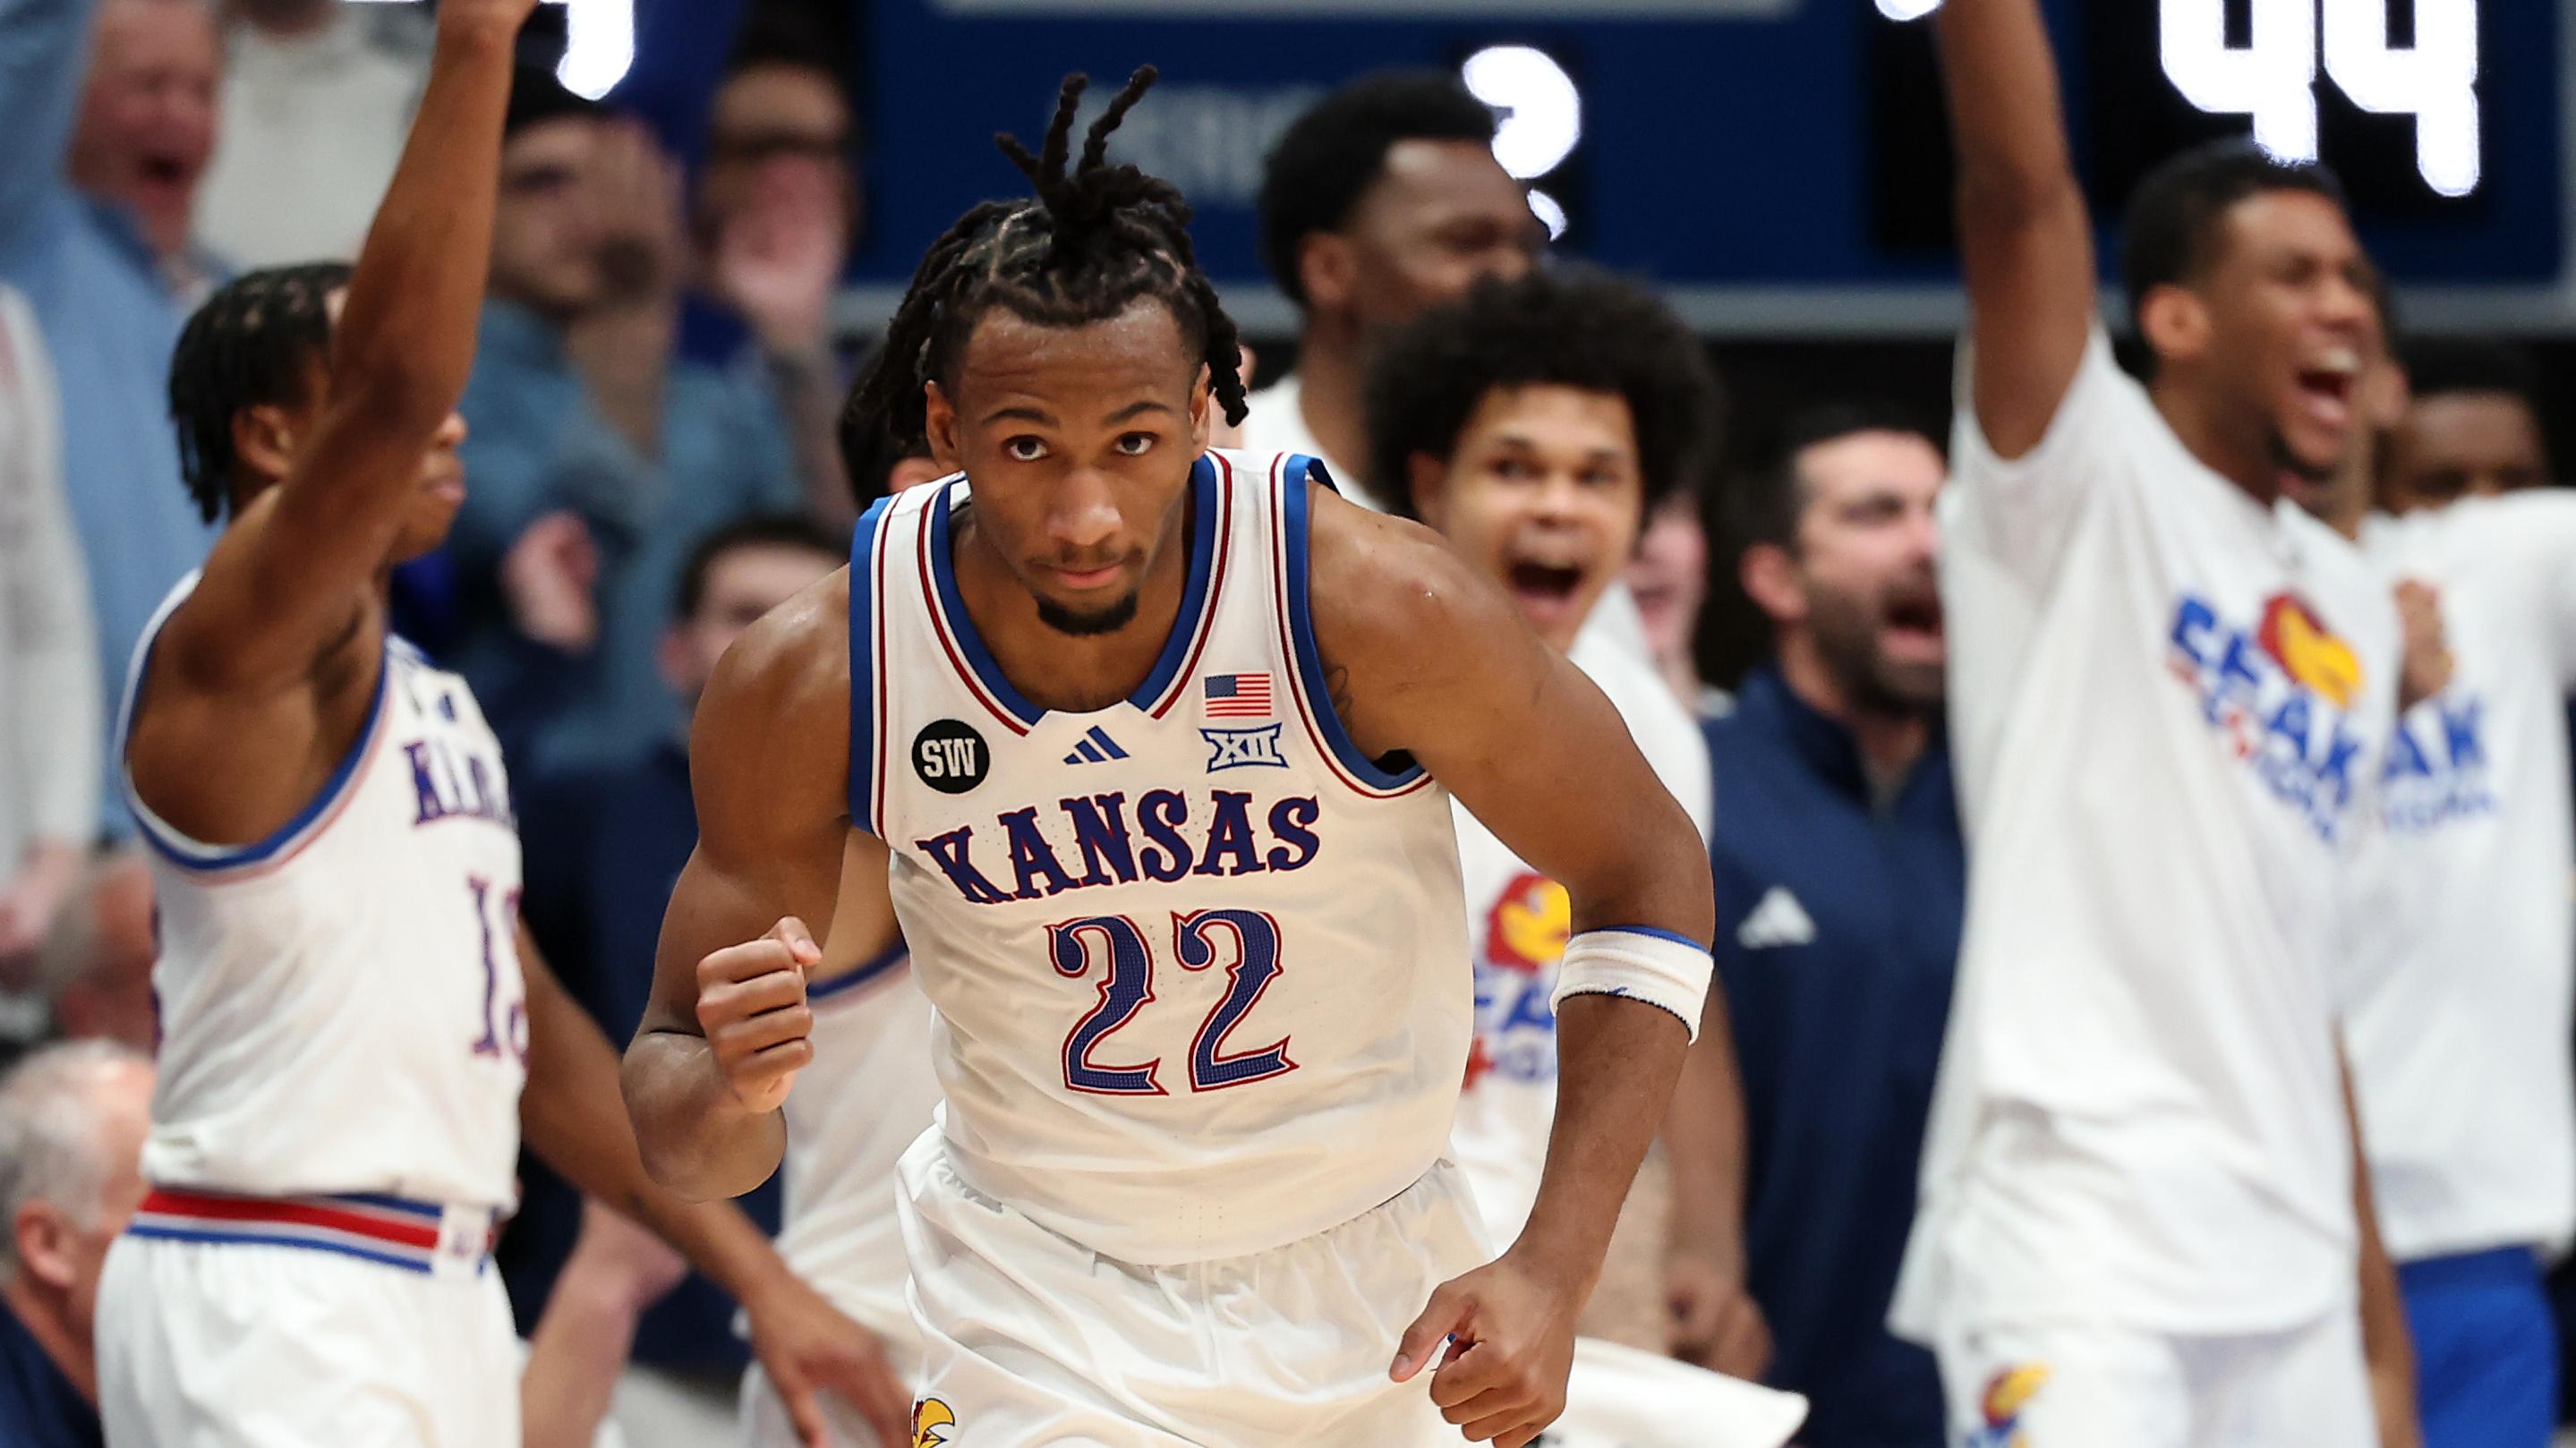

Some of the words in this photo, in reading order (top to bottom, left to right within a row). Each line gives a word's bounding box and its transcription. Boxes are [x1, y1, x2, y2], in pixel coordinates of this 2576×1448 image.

[920, 737, 977, 778] SW
[1198, 721, 1290, 774] XII
[914, 788, 1321, 905] KANSAS
[1043, 907, 1301, 1096] 22
